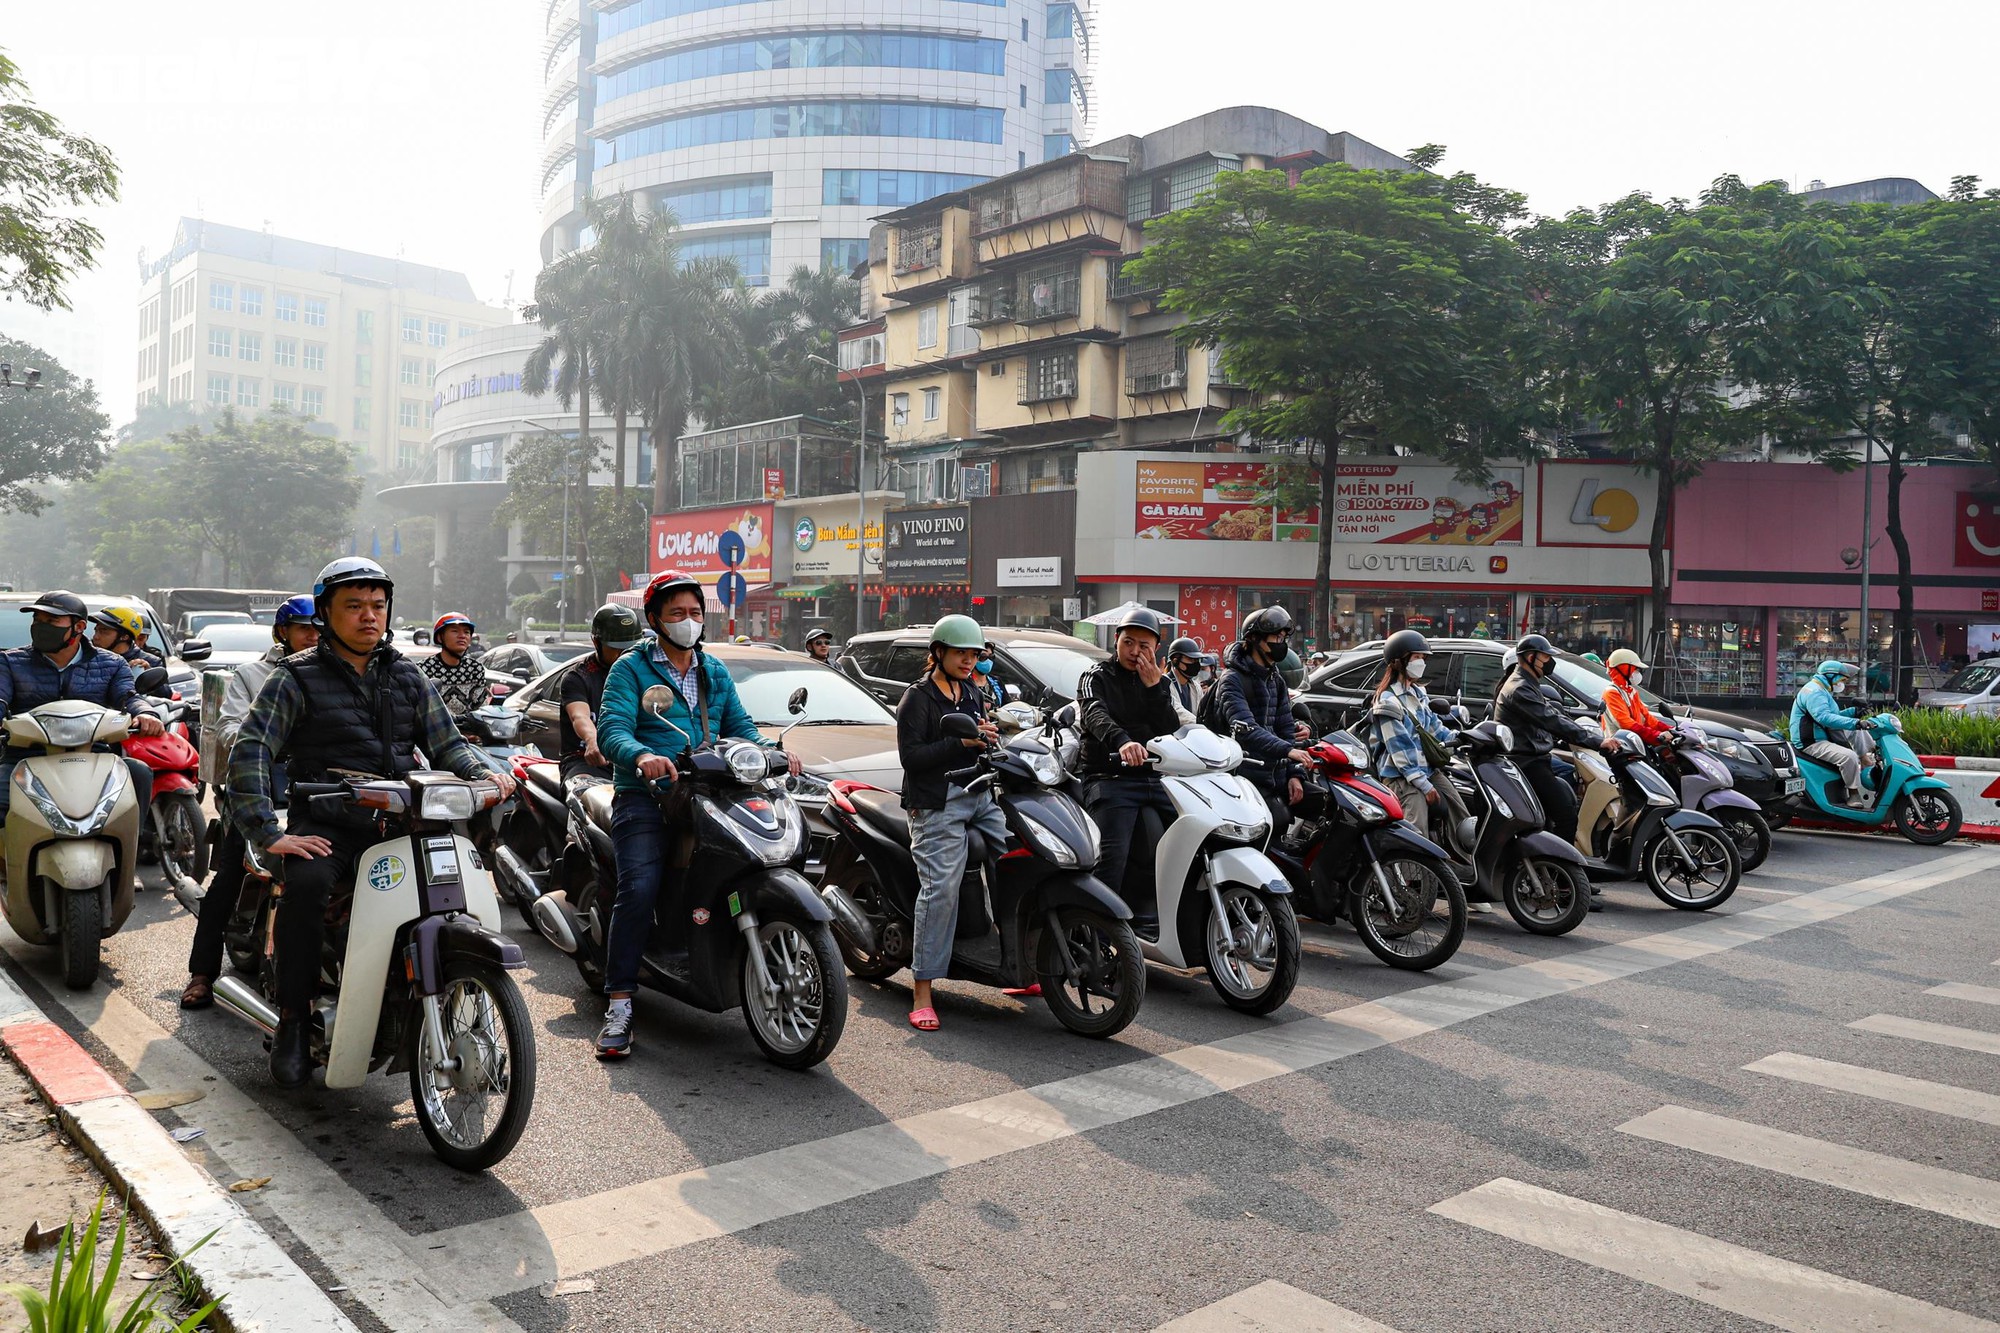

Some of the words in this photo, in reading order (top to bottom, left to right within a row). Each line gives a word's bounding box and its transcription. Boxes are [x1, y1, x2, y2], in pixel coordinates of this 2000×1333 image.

[1140, 468, 1156, 476] My
[1139, 478, 1198, 486] FAVORITE,
[1337, 478, 1382, 496] MIỄN
[1385, 480, 1414, 495] PHÍ
[1352, 499, 1425, 509] 1900-6778
[1141, 504, 1164, 516] GÀ
[1167, 504, 1203, 516] RÁN
[1365, 513, 1395, 522] HÀNG
[902, 519, 932, 535] VINO
[934, 516, 964, 533] FINO
[1337, 524, 1358, 535] TẬN
[1360, 525, 1379, 533] NƠI
[658, 531, 692, 559] LOVE
[916, 538, 933, 547] World
[934, 538, 939, 546] of
[940, 537, 955, 546] Wine
[1348, 553, 1475, 572] LOTTERIA
